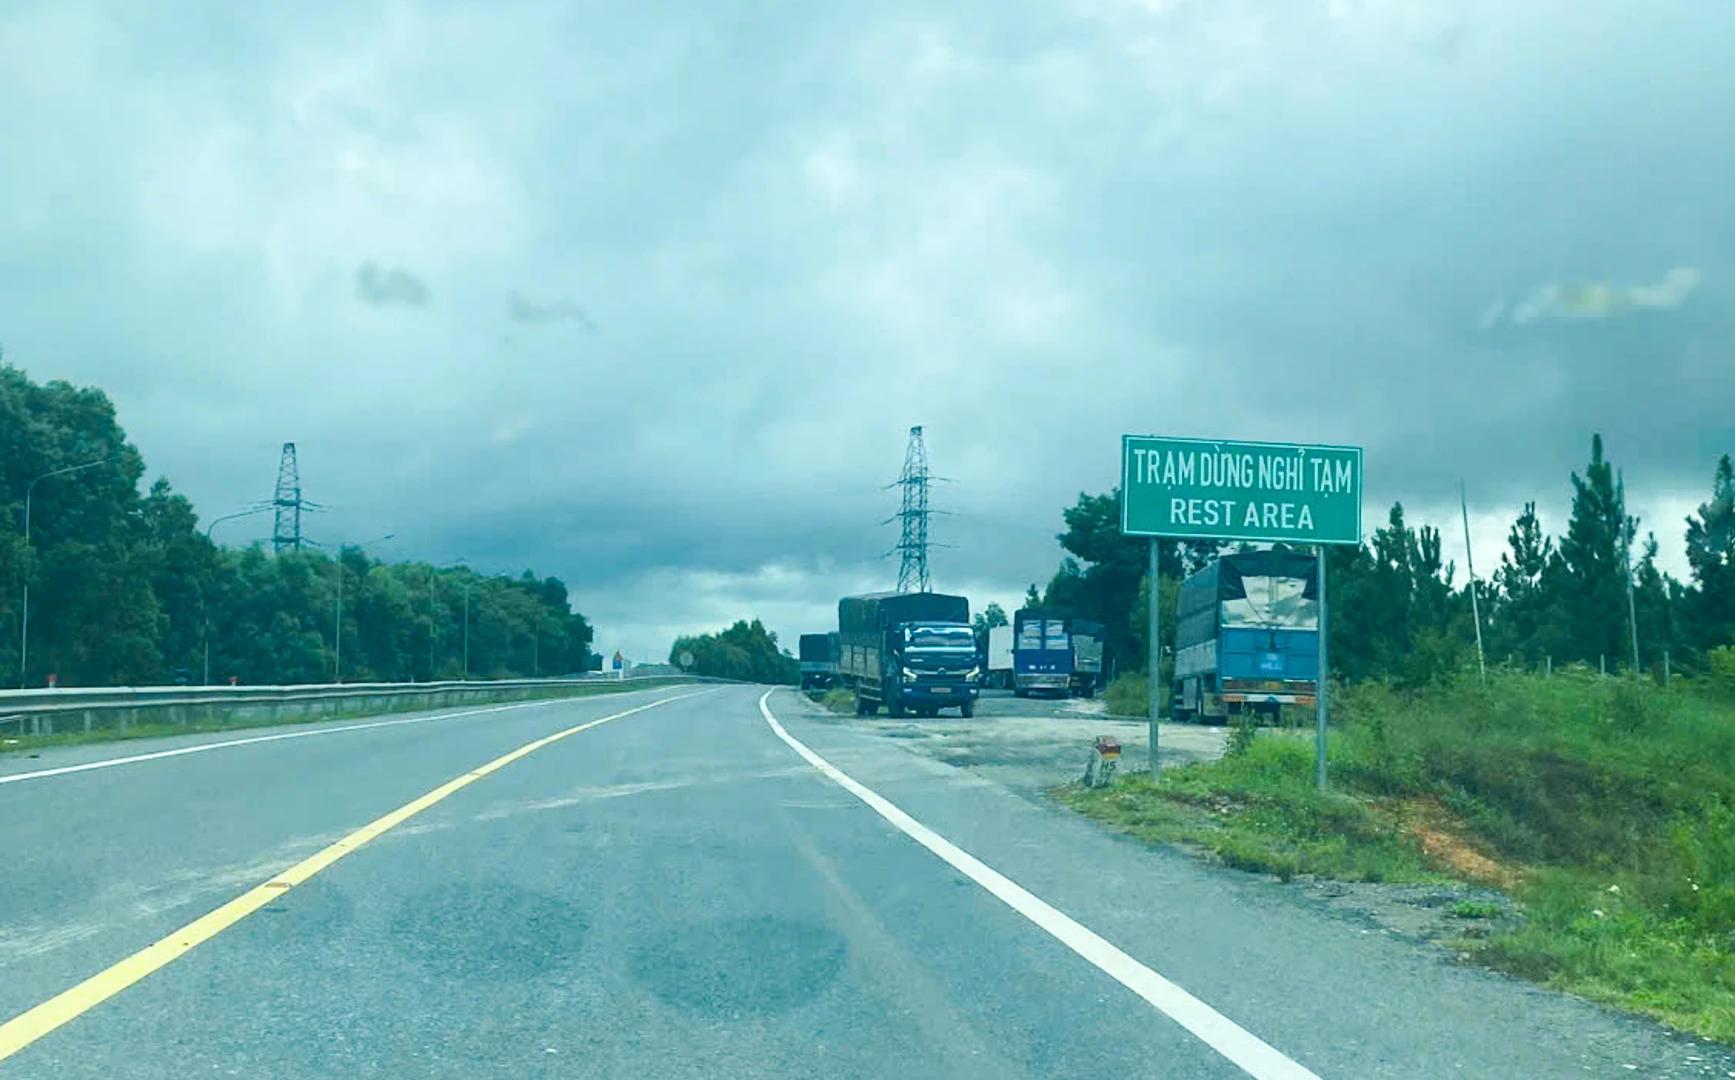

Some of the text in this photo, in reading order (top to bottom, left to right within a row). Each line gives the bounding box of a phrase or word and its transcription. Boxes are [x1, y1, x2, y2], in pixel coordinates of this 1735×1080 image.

[1134, 444, 1352, 498] TRẠM DỪNG NGHỈ TẠM
[1170, 498, 1314, 530] REST AREA
